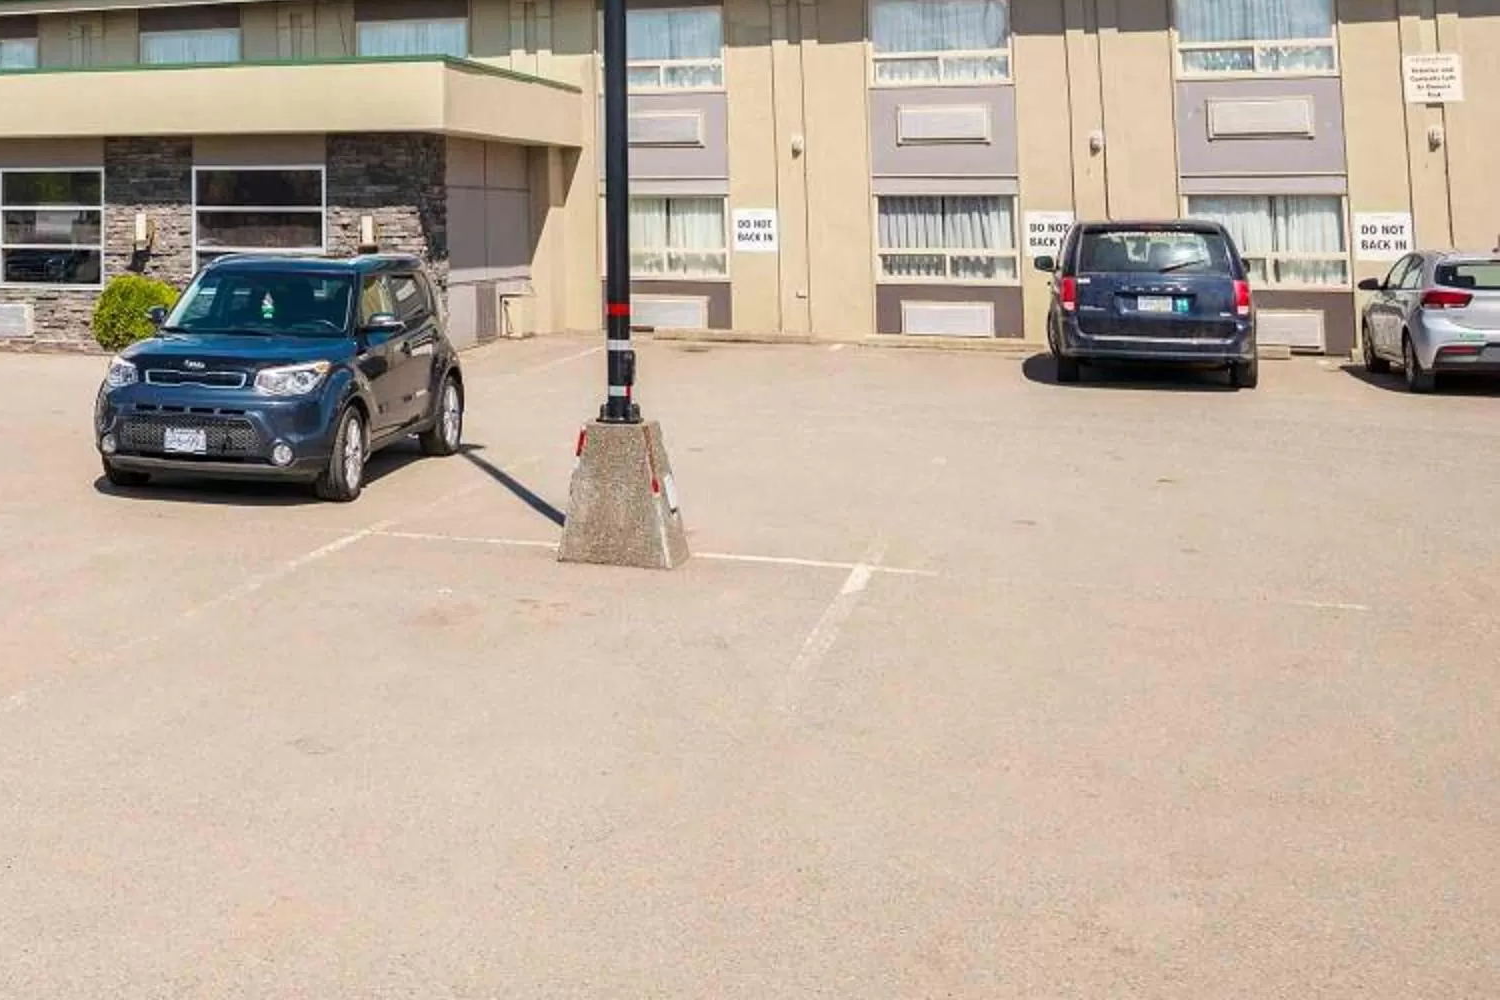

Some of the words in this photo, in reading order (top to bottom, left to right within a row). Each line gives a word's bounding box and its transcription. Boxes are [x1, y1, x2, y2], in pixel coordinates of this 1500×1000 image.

[737, 219, 751, 229] DO
[753, 219, 772, 229] NOT
[1029, 223, 1045, 233] DO
[1361, 224, 1377, 235] DO
[1381, 224, 1405, 235] NOT
[737, 232, 760, 242] BACK
[763, 232, 773, 242] IN
[1029, 237, 1057, 247] BACK
[1361, 239, 1391, 250] BACK
[1395, 239, 1407, 250] IN
